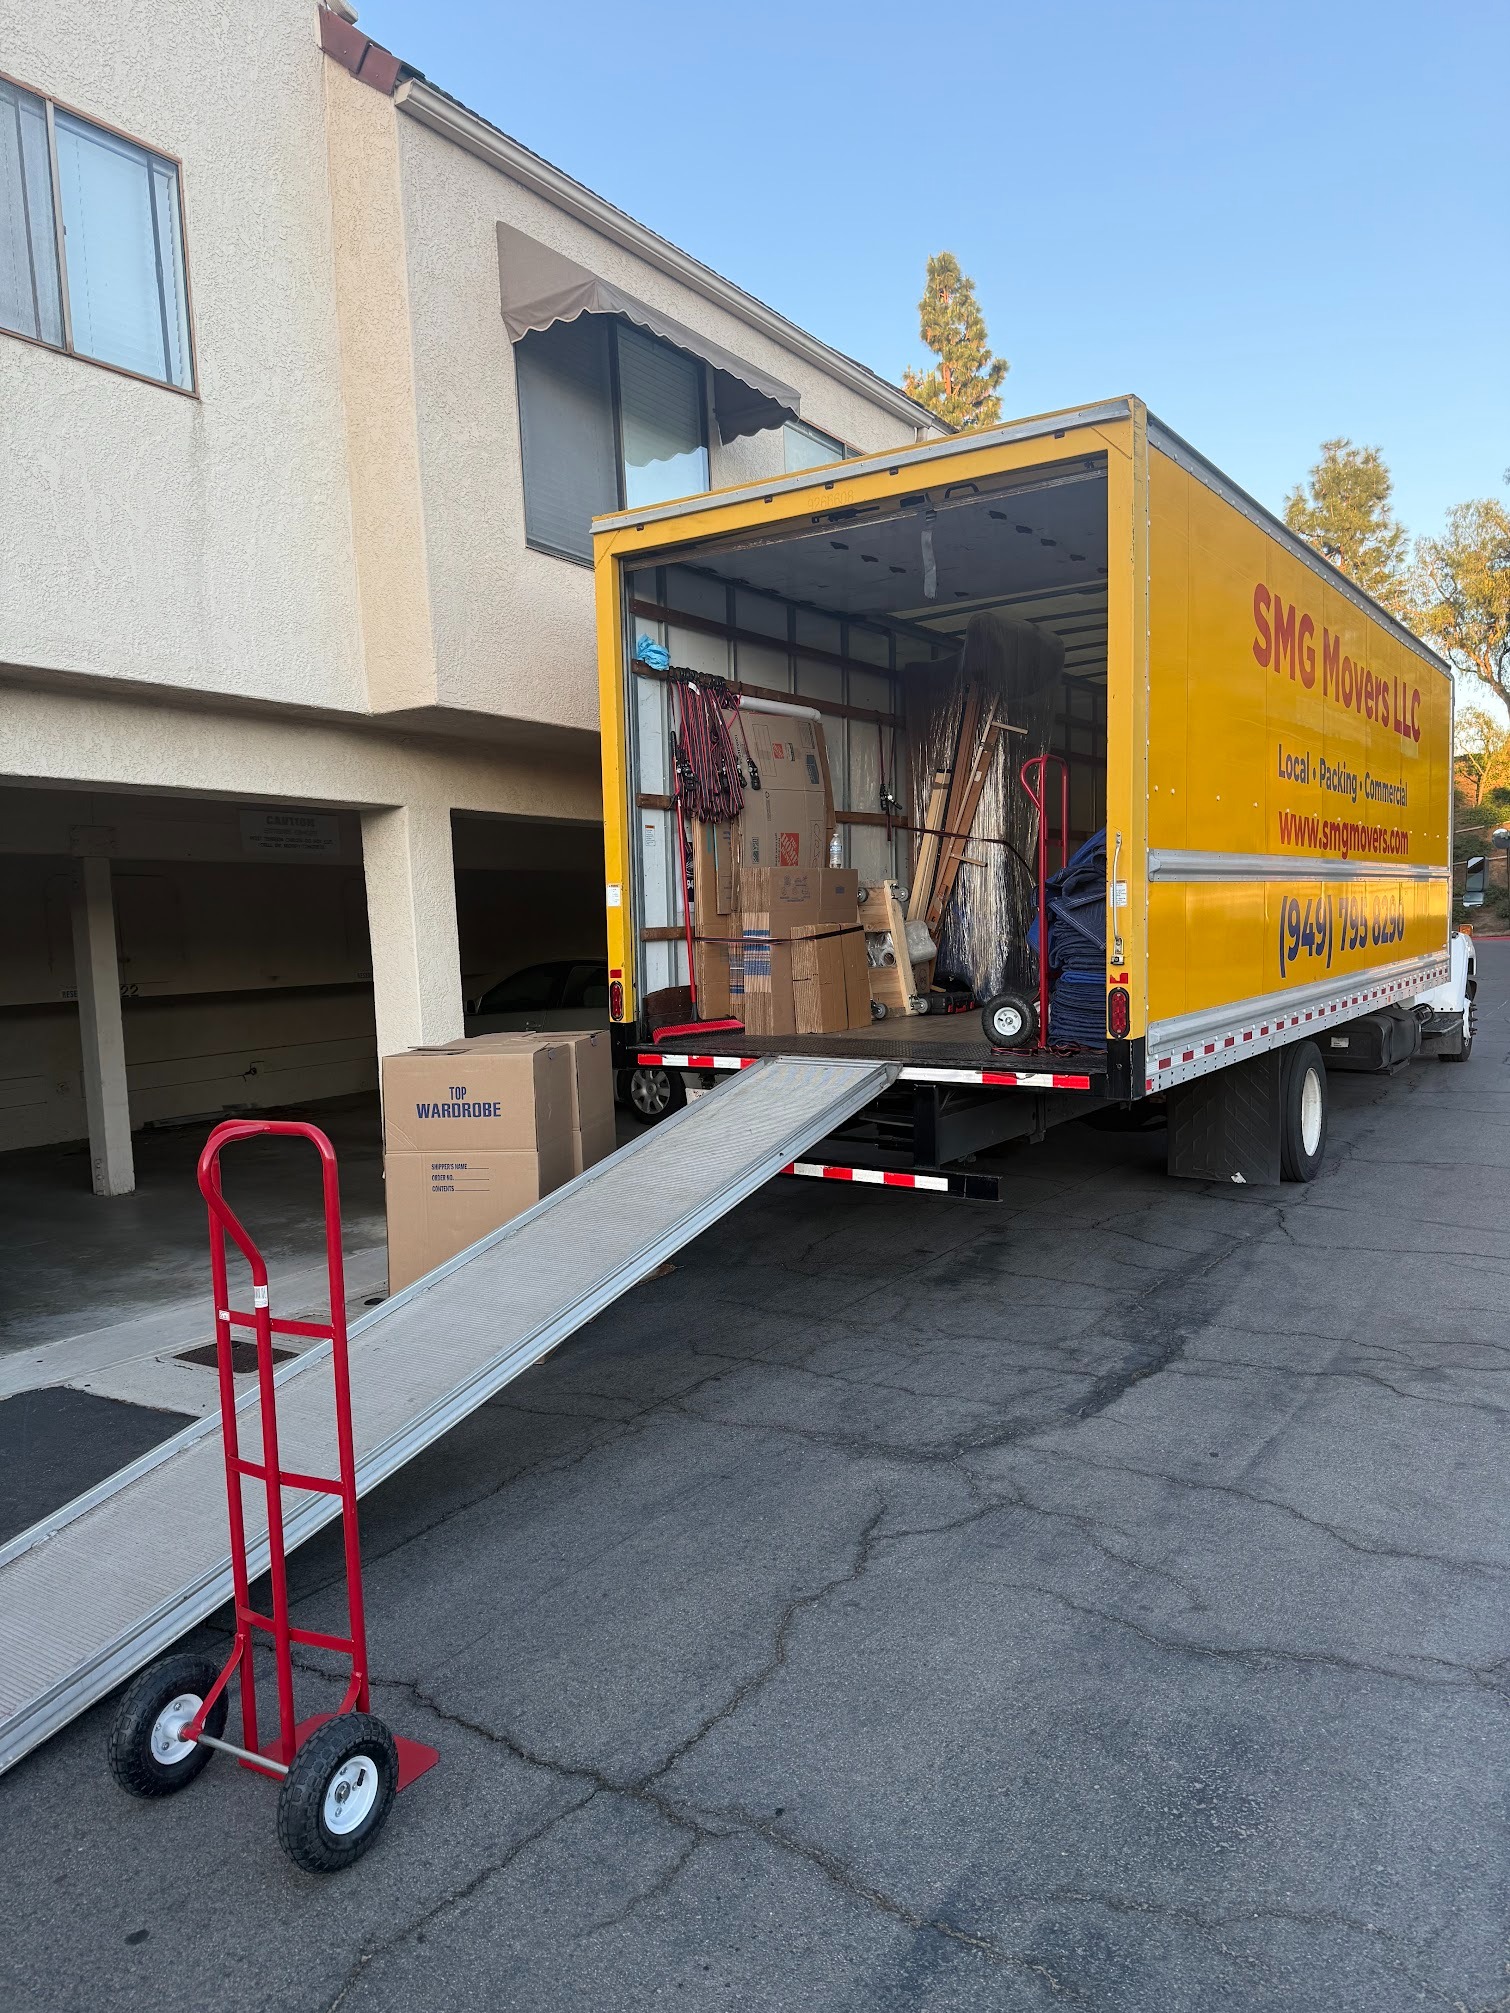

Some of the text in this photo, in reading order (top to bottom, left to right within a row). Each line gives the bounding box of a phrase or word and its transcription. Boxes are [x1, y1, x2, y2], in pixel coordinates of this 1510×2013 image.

[1252, 582, 1421, 743] SMG Movers LLC
[1278, 743, 1408, 807] Local Packing Commercial
[1278, 810, 1409, 860] www.smgmovers.com
[1279, 894, 1334, 979] (949)
[1338, 897, 1368, 952] 795
[416, 1102, 502, 1119] WARDROBE
[448, 1086, 467, 1101] TOP
